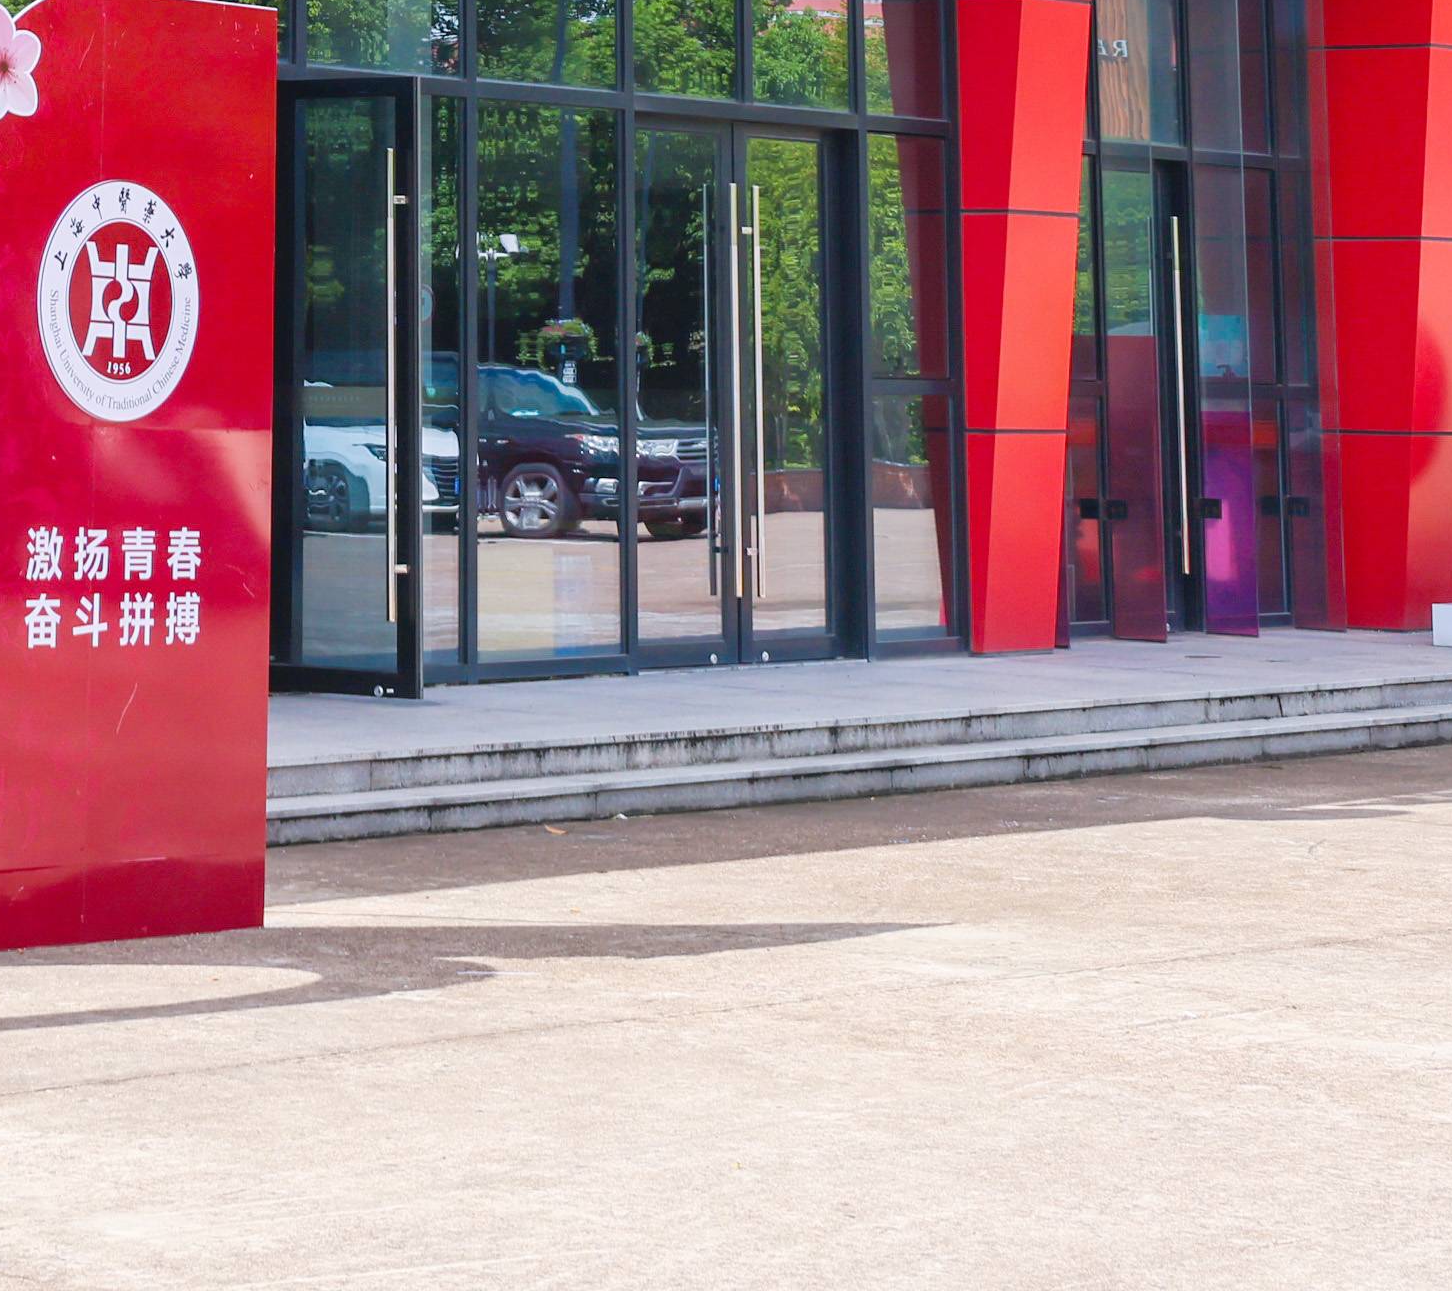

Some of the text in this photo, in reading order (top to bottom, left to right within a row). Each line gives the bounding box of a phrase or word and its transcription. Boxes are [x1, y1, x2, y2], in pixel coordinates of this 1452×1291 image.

[49, 289, 191, 410] Shanghai University of Traditional Chinese Medicine
[106, 361, 131, 375] 1956
[25, 525, 203, 581] 激扬青春
[24, 591, 202, 649] 奋斗拼搏
